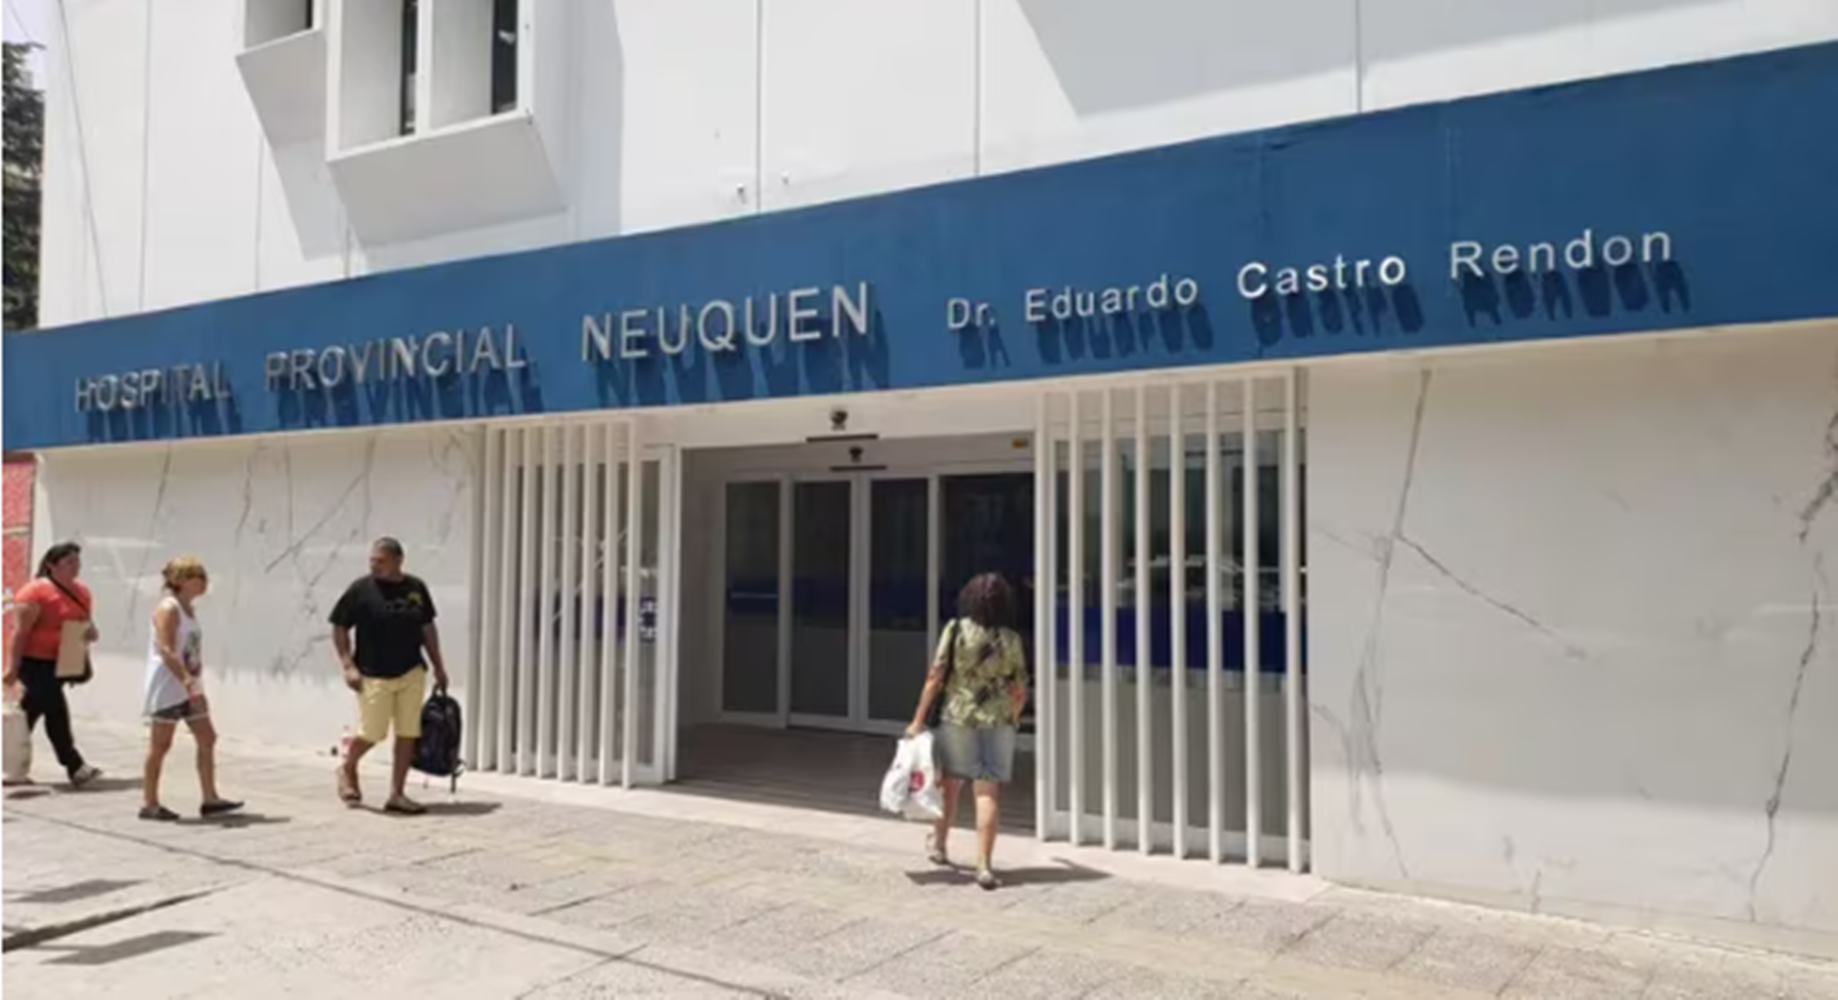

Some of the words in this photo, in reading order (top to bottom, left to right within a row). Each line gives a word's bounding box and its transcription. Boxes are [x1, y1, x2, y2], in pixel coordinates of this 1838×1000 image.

[75, 361, 230, 412] HOSPITAL
[264, 324, 526, 392] PROVINCIAL
[581, 281, 869, 361] NEUQUEN
[947, 298, 996, 329] Dr.
[1025, 273, 1198, 322] Eduardo
[1237, 255, 1406, 299] Castro
[1450, 229, 1671, 279] Rendon
